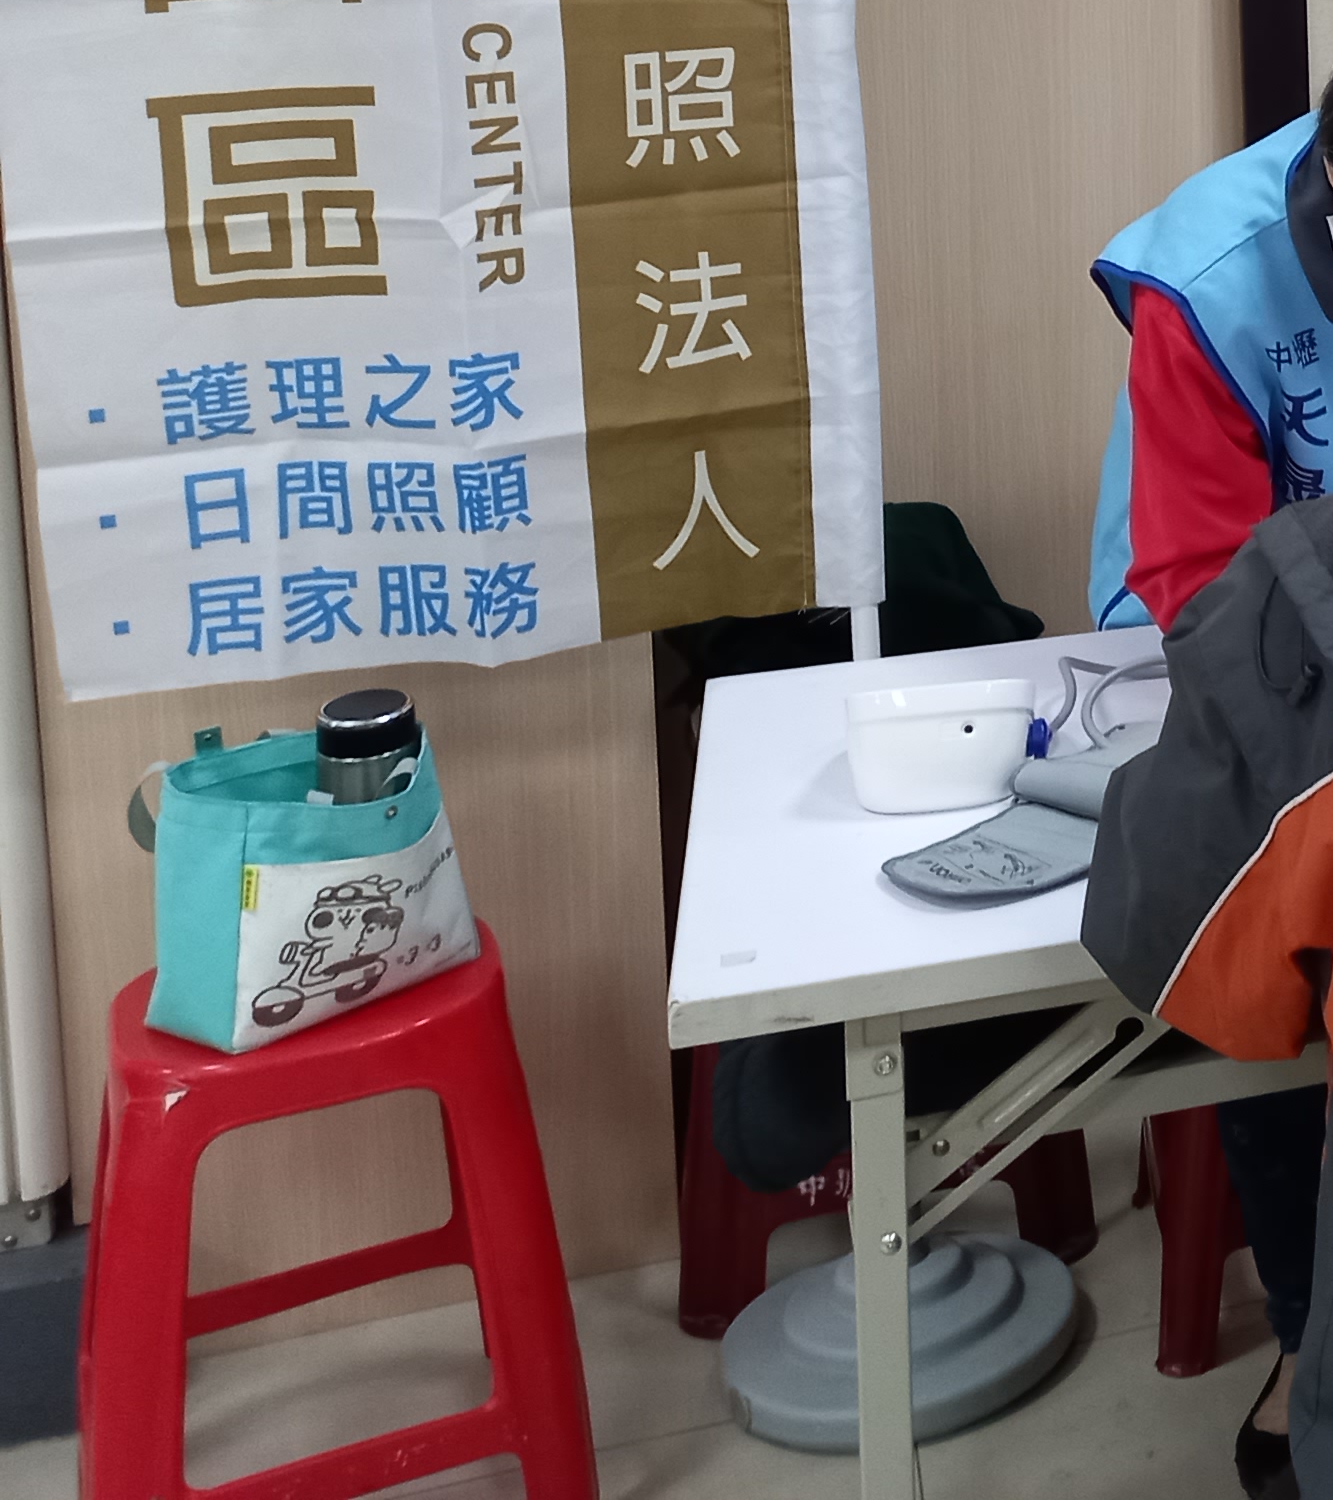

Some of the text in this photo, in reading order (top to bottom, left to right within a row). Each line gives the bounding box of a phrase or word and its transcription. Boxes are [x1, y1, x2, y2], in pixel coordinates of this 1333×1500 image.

[461, 23, 525, 293] CENTER
[156, 352, 524, 444] 護理之家
[184, 453, 532, 550] 日間照顧
[186, 561, 539, 657] 居家服務
